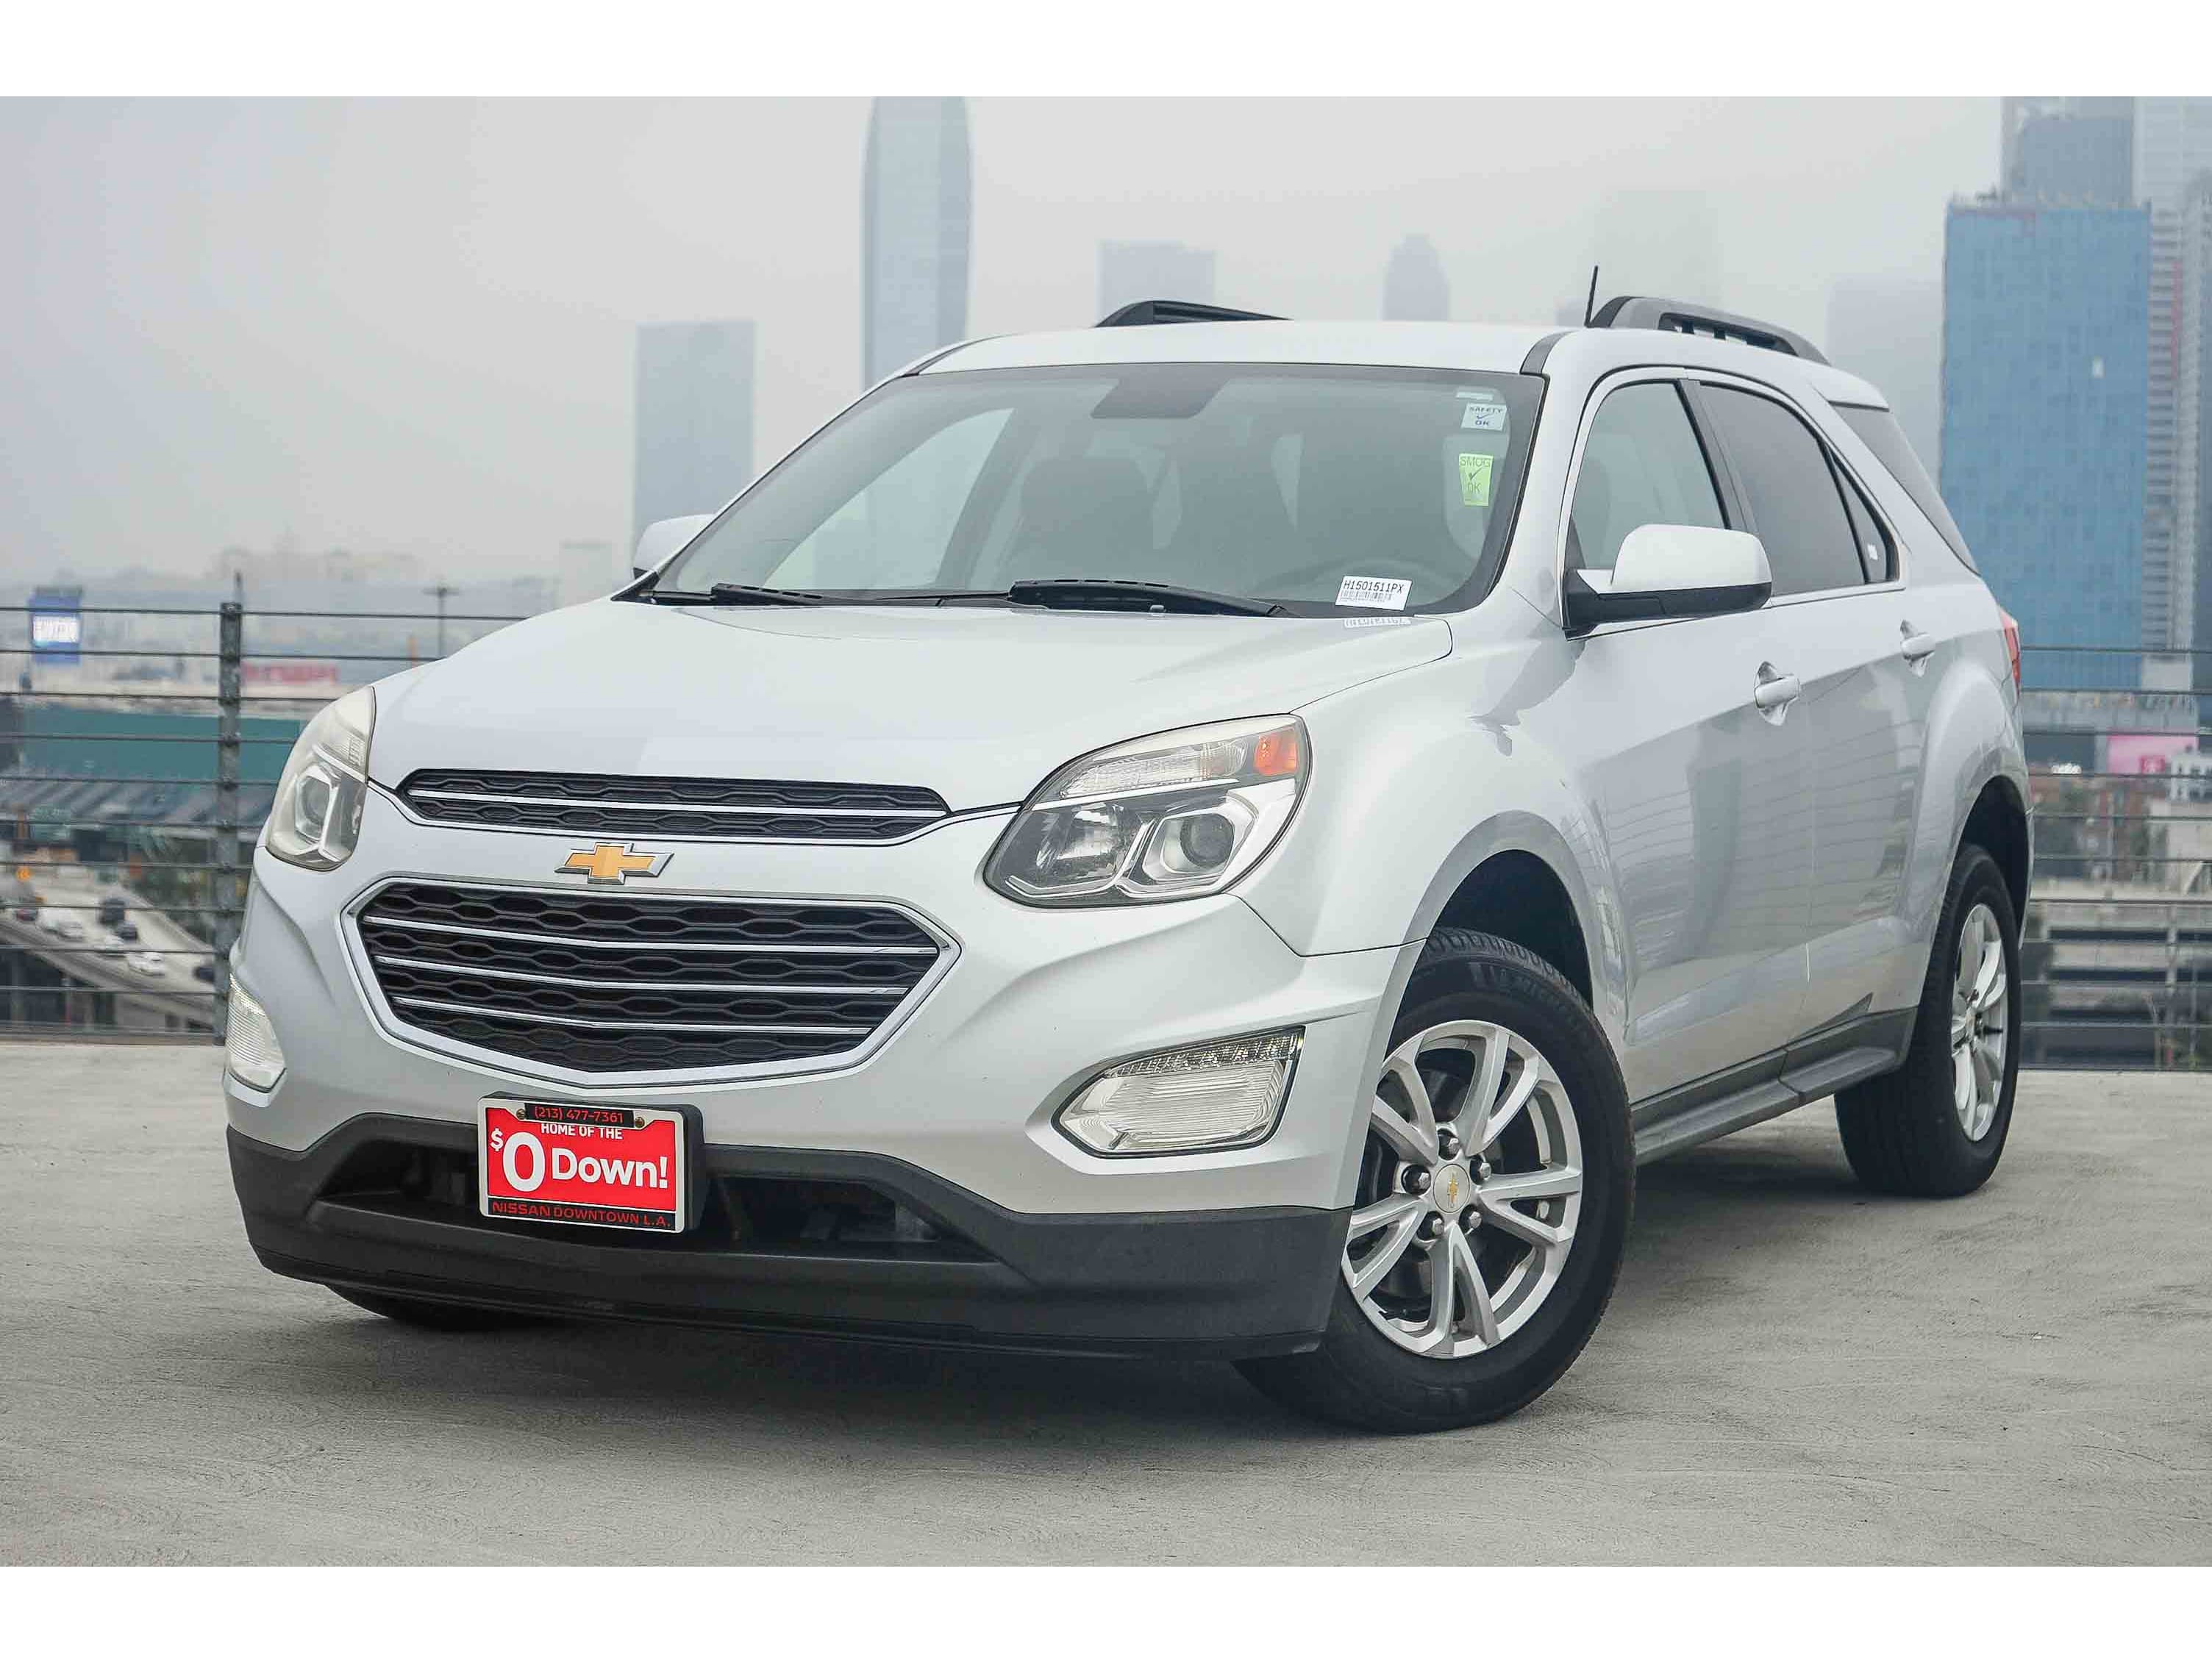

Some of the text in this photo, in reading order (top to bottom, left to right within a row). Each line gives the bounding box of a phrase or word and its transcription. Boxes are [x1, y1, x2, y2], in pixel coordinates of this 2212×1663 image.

[1470, 406, 1503, 414] SAFETY
[1460, 456, 1491, 468] SMOG
[1467, 482, 1481, 494] OK
[535, 1106, 624, 1123] (213) 477-7361
[541, 1123, 623, 1140] HOME OF THE
[552, 1147, 668, 1189] Down!
[492, 1201, 671, 1228] NISSAN DOWNTOWN L.A.
